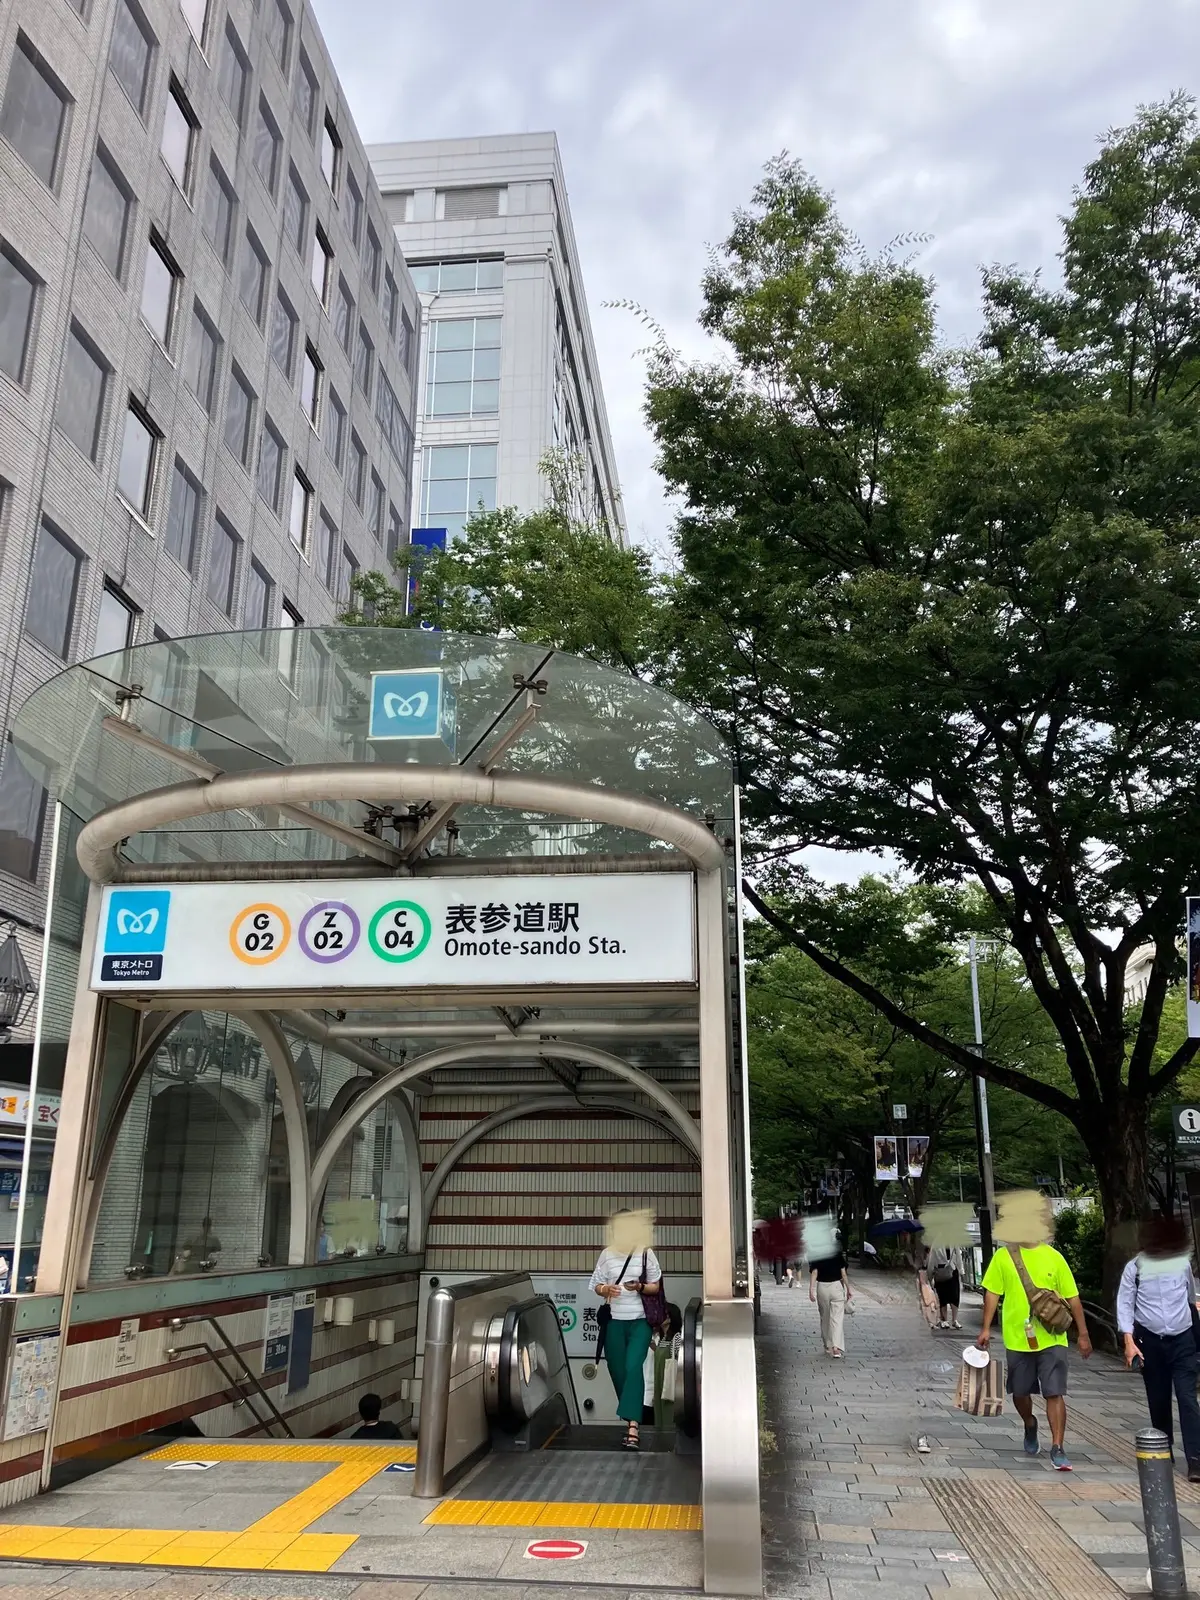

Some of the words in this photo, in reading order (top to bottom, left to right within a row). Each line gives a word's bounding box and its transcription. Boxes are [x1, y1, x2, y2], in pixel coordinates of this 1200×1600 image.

[253, 913, 270, 930] G
[323, 911, 338, 928] Z
[393, 910, 407, 928] C
[444, 902, 580, 935] 表参道駅
[244, 932, 275, 951] 02
[313, 930, 343, 950] 02
[384, 930, 414, 949] 04
[444, 936, 581, 957] Omote-sando
[588, 935, 627, 955] Sta.
[111, 960, 153, 969] 東京メトロ
[113, 969, 131, 977] Tokyo
[562, 1310, 568, 1318] C
